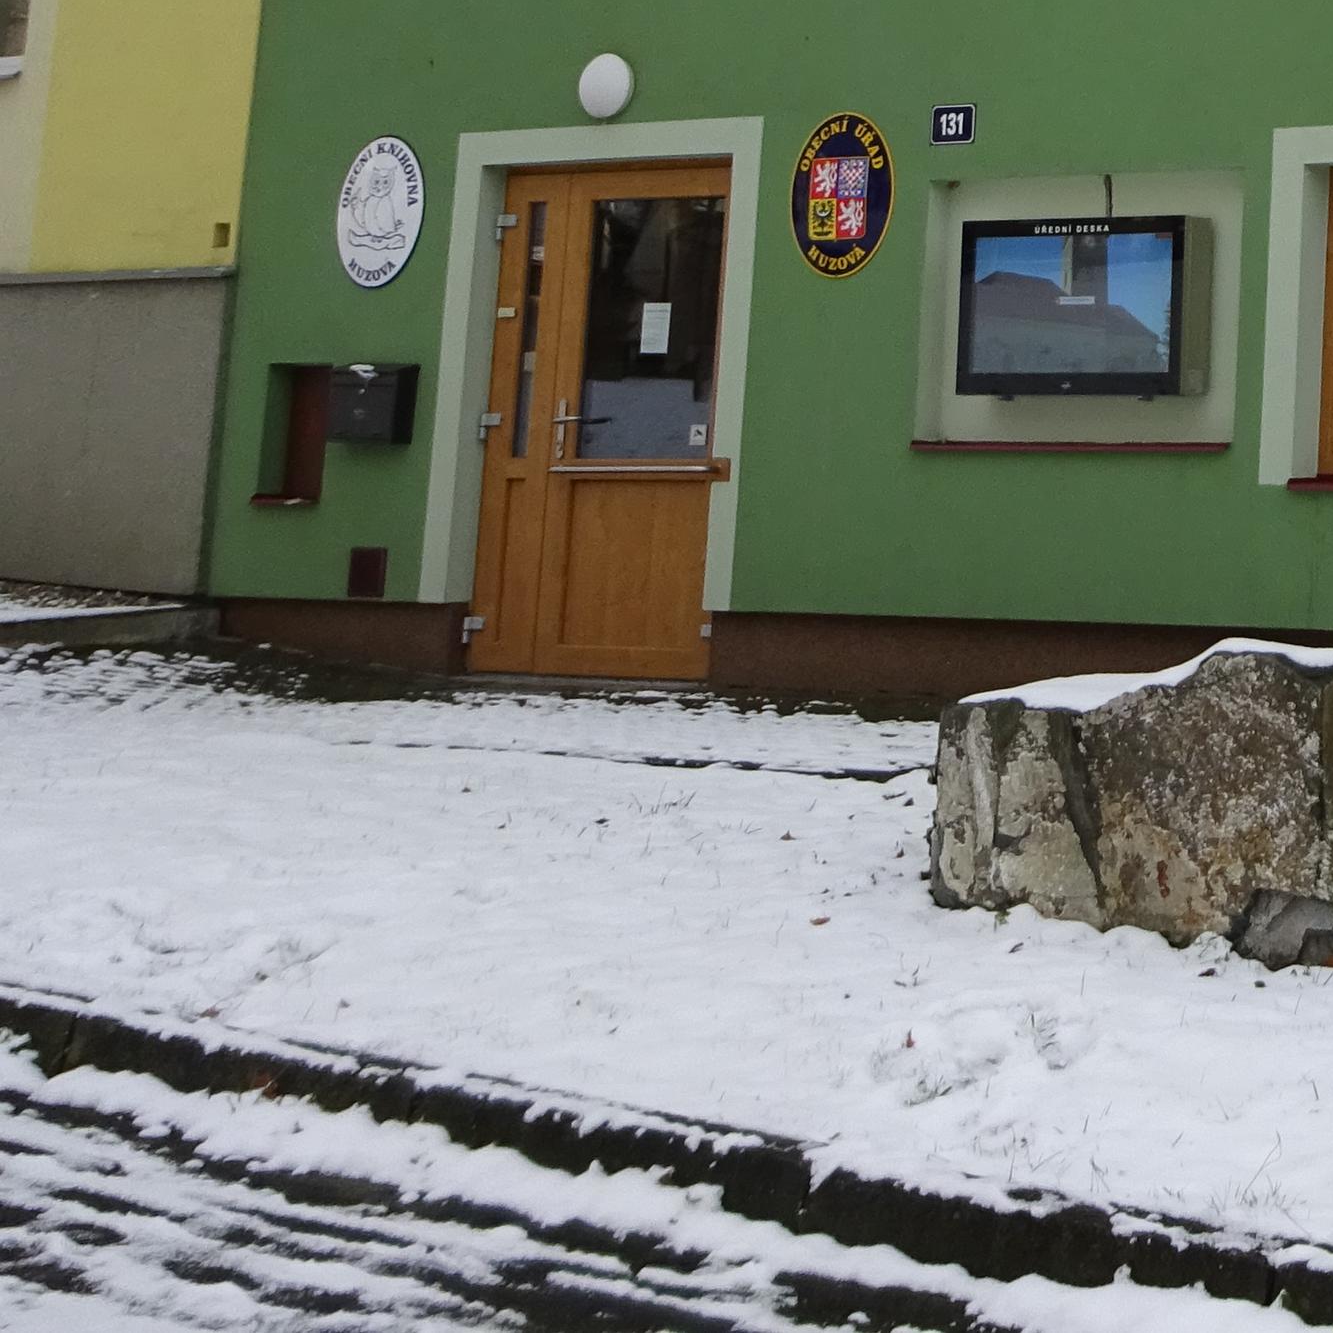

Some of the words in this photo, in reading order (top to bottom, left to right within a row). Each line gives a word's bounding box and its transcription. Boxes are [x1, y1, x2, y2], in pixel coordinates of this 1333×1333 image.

[940, 113, 964, 136] 131
[801, 117, 849, 172] OBECNÍ
[855, 123, 884, 170] ÚŘAD
[376, 143, 418, 207] KNIHOVNA
[1076, 224, 1110, 233] DESKA
[807, 244, 866, 270] HUZOVÁ
